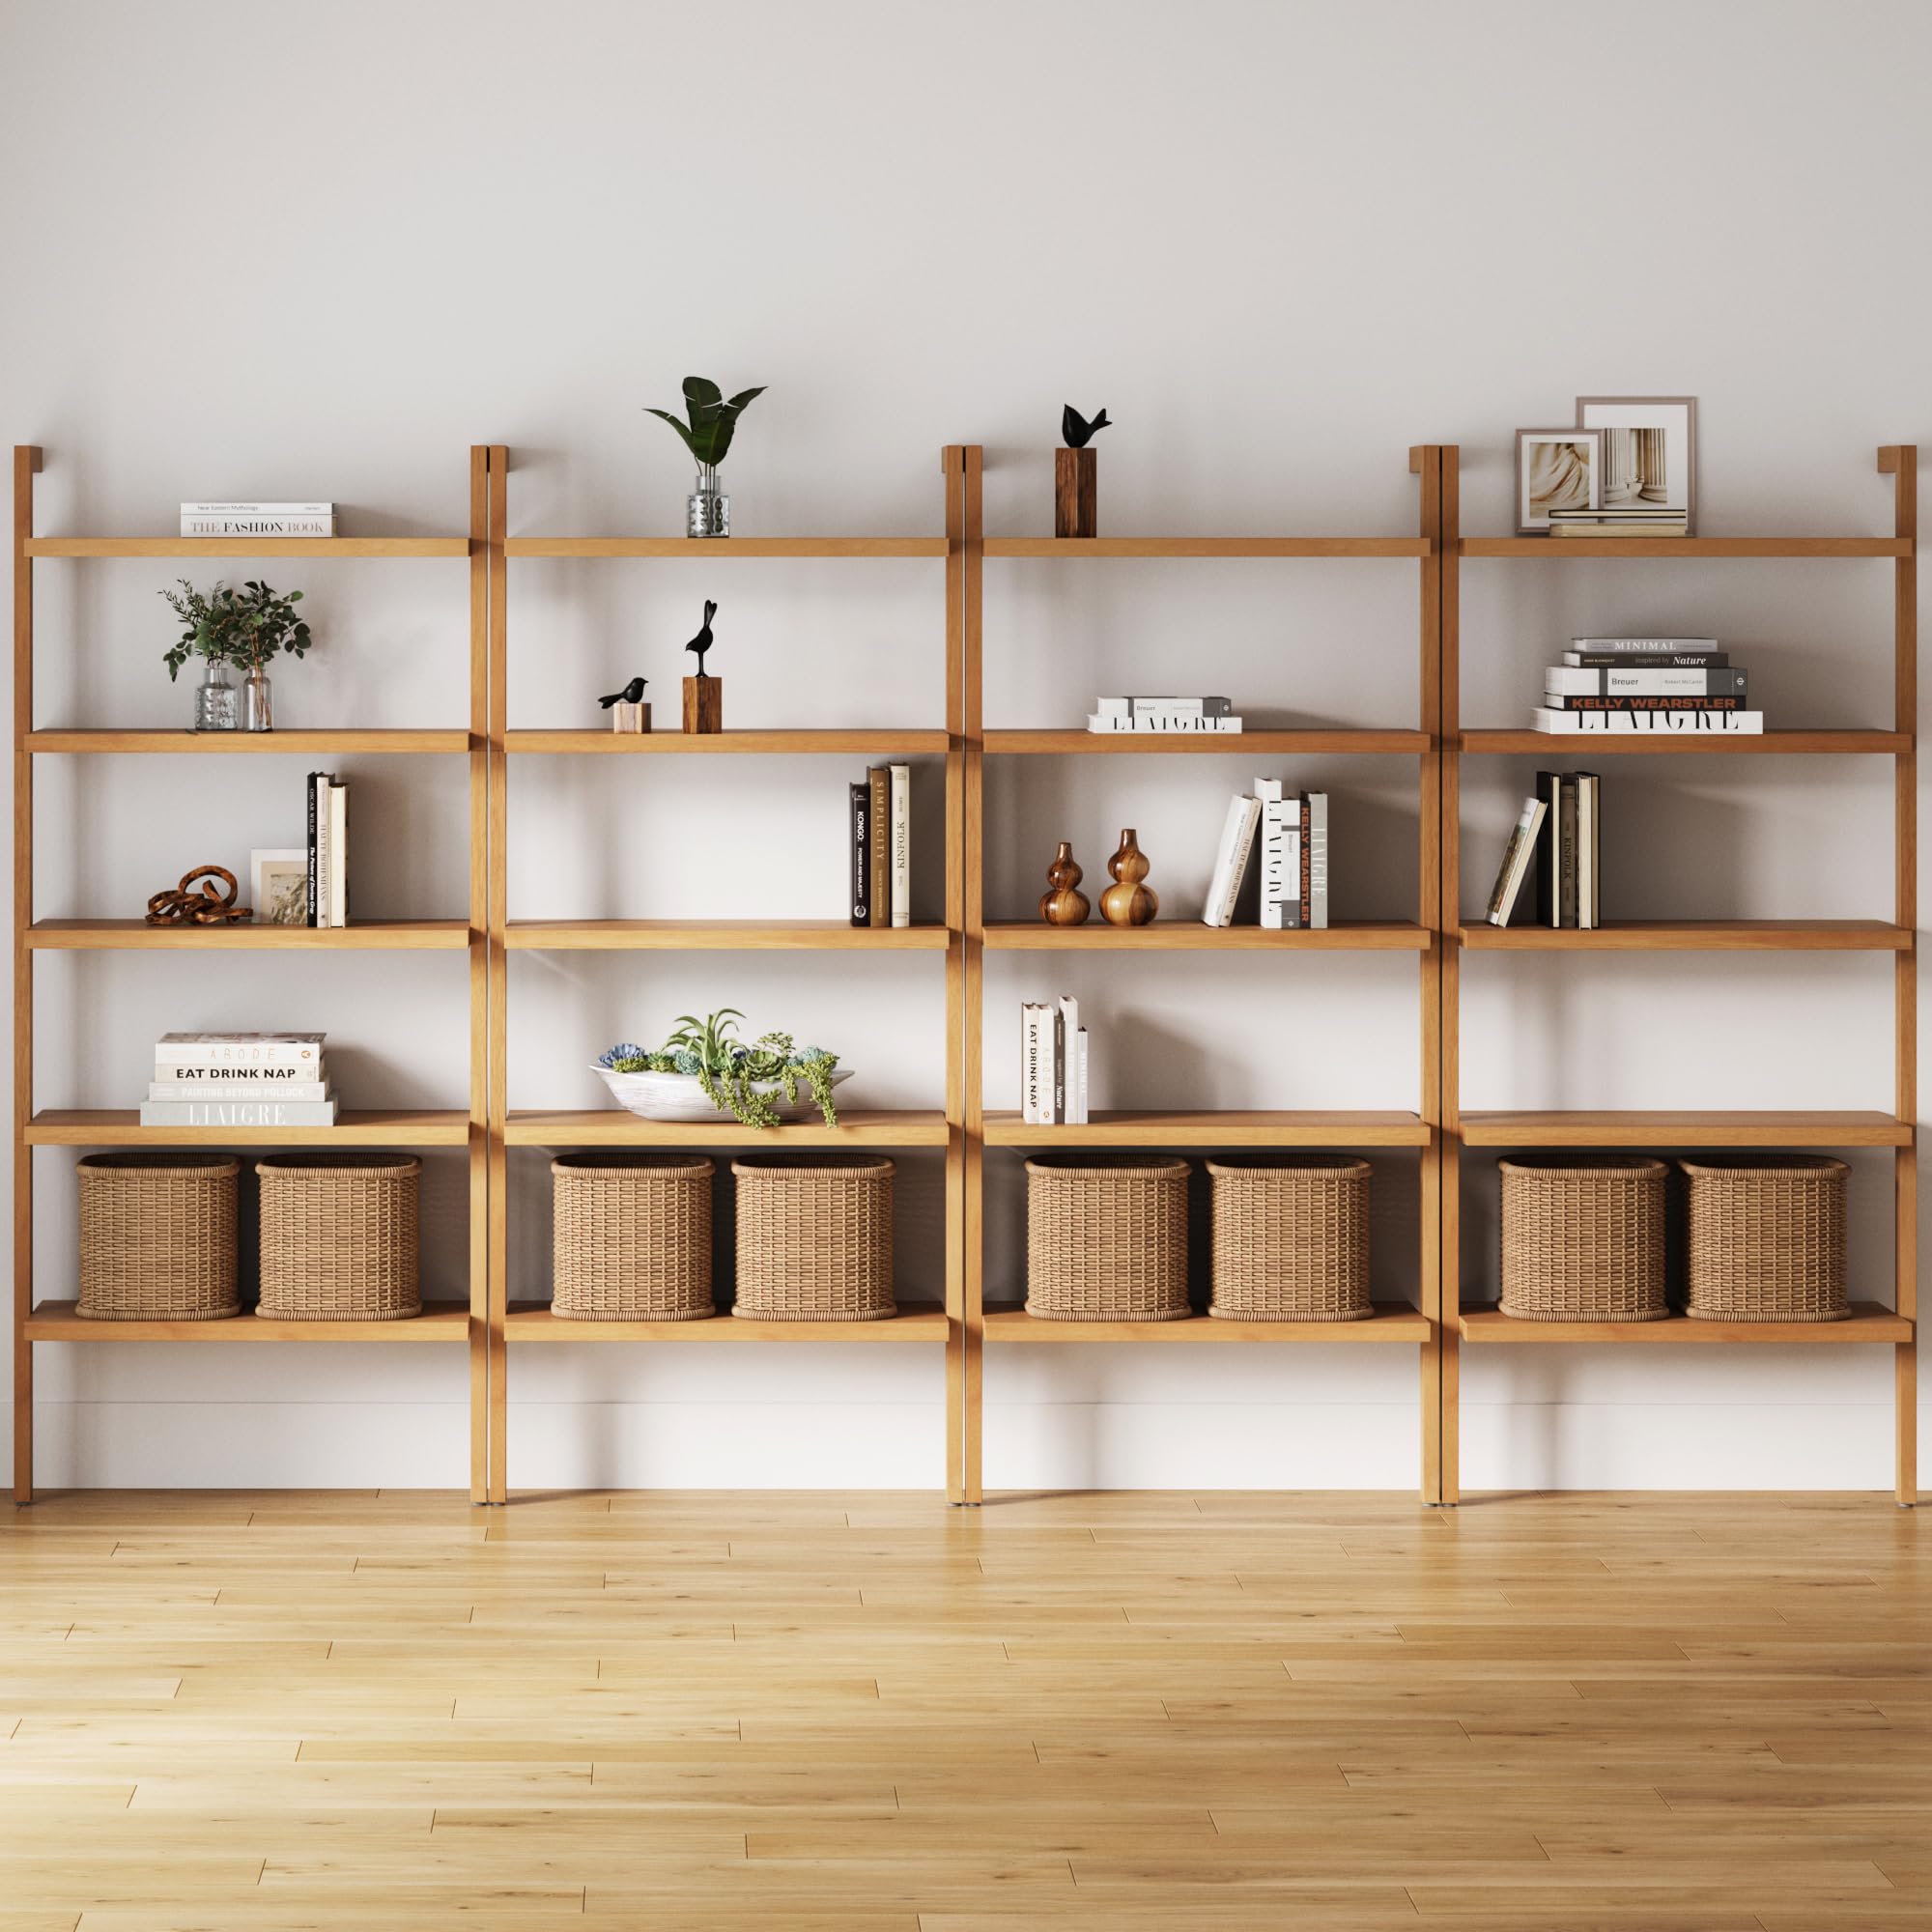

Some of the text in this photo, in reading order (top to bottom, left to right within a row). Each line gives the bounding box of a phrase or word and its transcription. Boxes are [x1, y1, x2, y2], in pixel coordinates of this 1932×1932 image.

[190, 522, 324, 532] THE FASHION BOOK
[1614, 641, 1677, 650] MINIMAL
[1672, 656, 1707, 666] Nature
[1611, 677, 1639, 686] Breuer
[1572, 697, 1737, 709] KELLY WEARSTLER
[876, 781, 885, 860] SIMPLICITY
[896, 821, 905, 868] KINFOLK
[1301, 807, 1310, 922] KELLY WEARSTLER
[176, 1068, 296, 1079] EAT DRINK NAP
